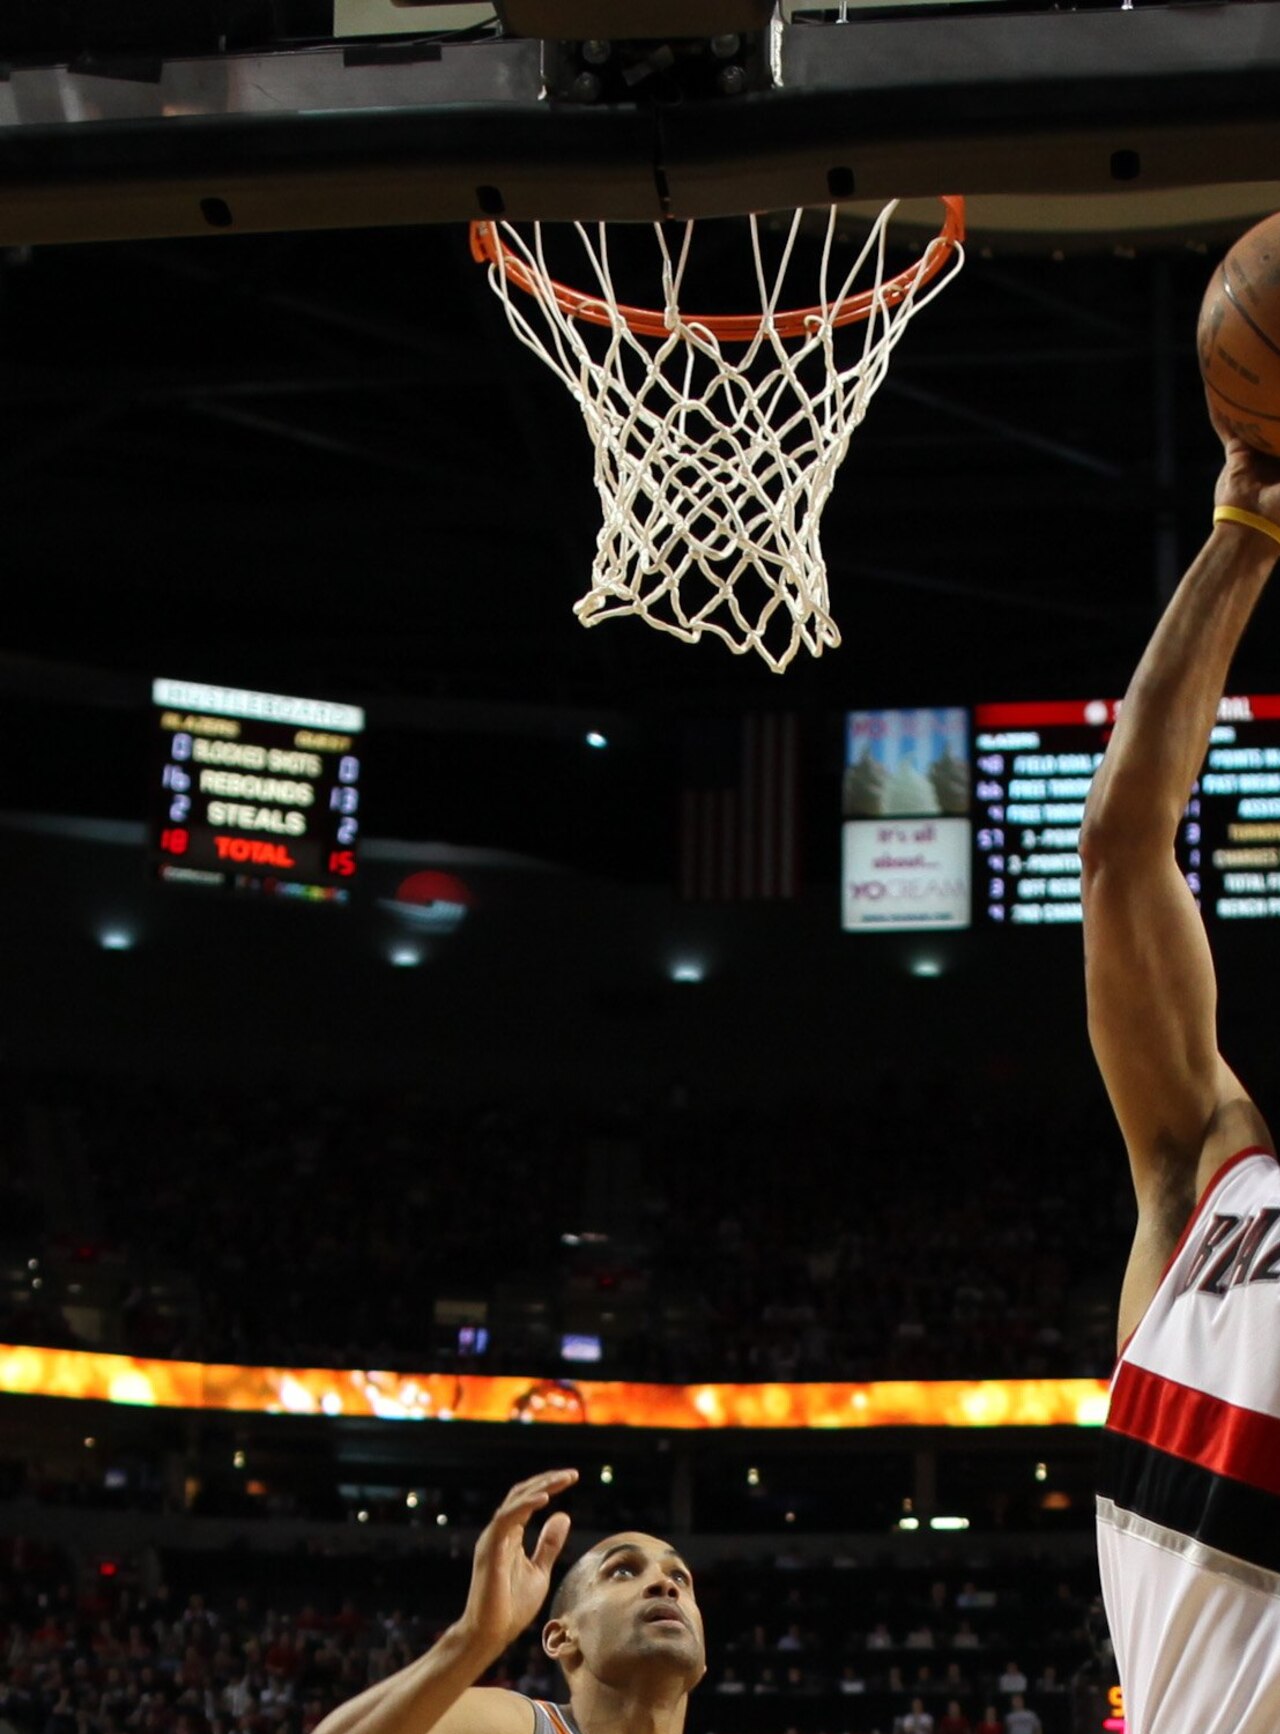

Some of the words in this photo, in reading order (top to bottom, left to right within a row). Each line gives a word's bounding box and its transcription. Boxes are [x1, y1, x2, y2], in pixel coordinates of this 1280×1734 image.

[199, 768, 315, 807] REBOUNDS
[207, 801, 307, 836] STEALS
[214, 836, 295, 868] TOTAL
